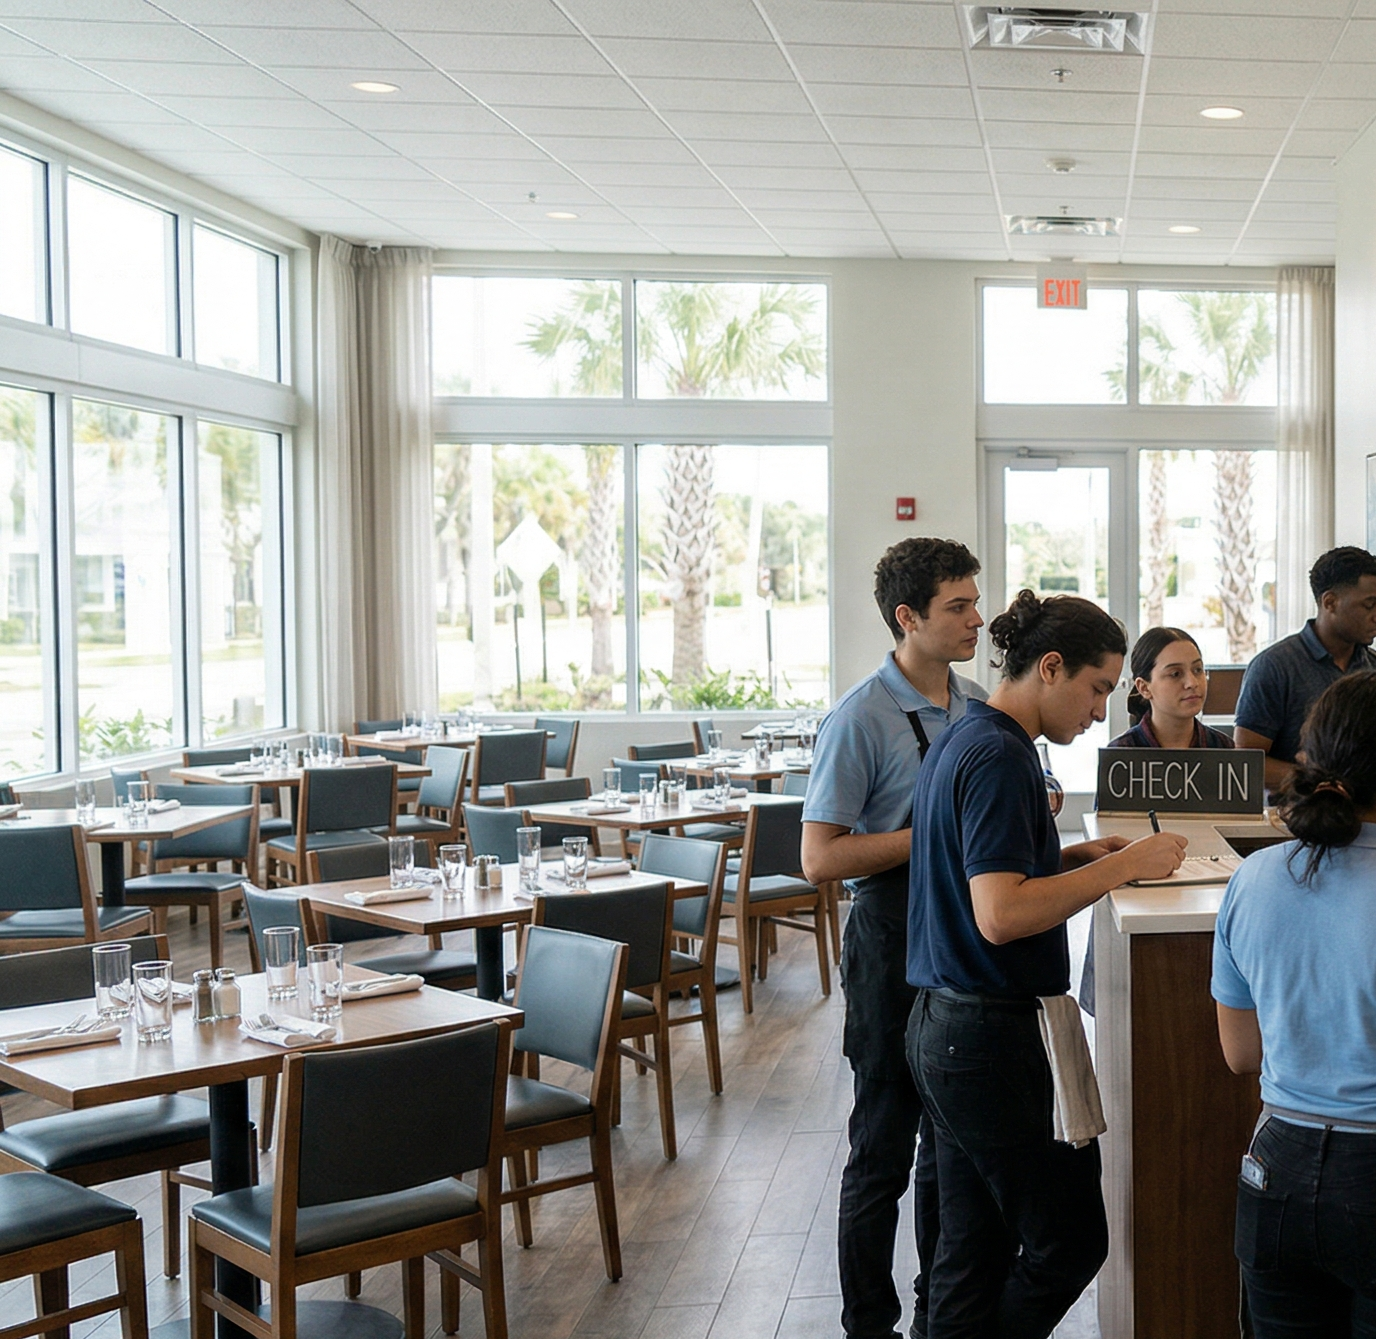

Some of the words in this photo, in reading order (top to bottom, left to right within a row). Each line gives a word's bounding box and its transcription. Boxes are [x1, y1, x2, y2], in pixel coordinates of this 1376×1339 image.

[1044, 278, 1081, 306] EXIT
[1108, 760, 1202, 801] CHECK
[1219, 762, 1248, 801] IN
